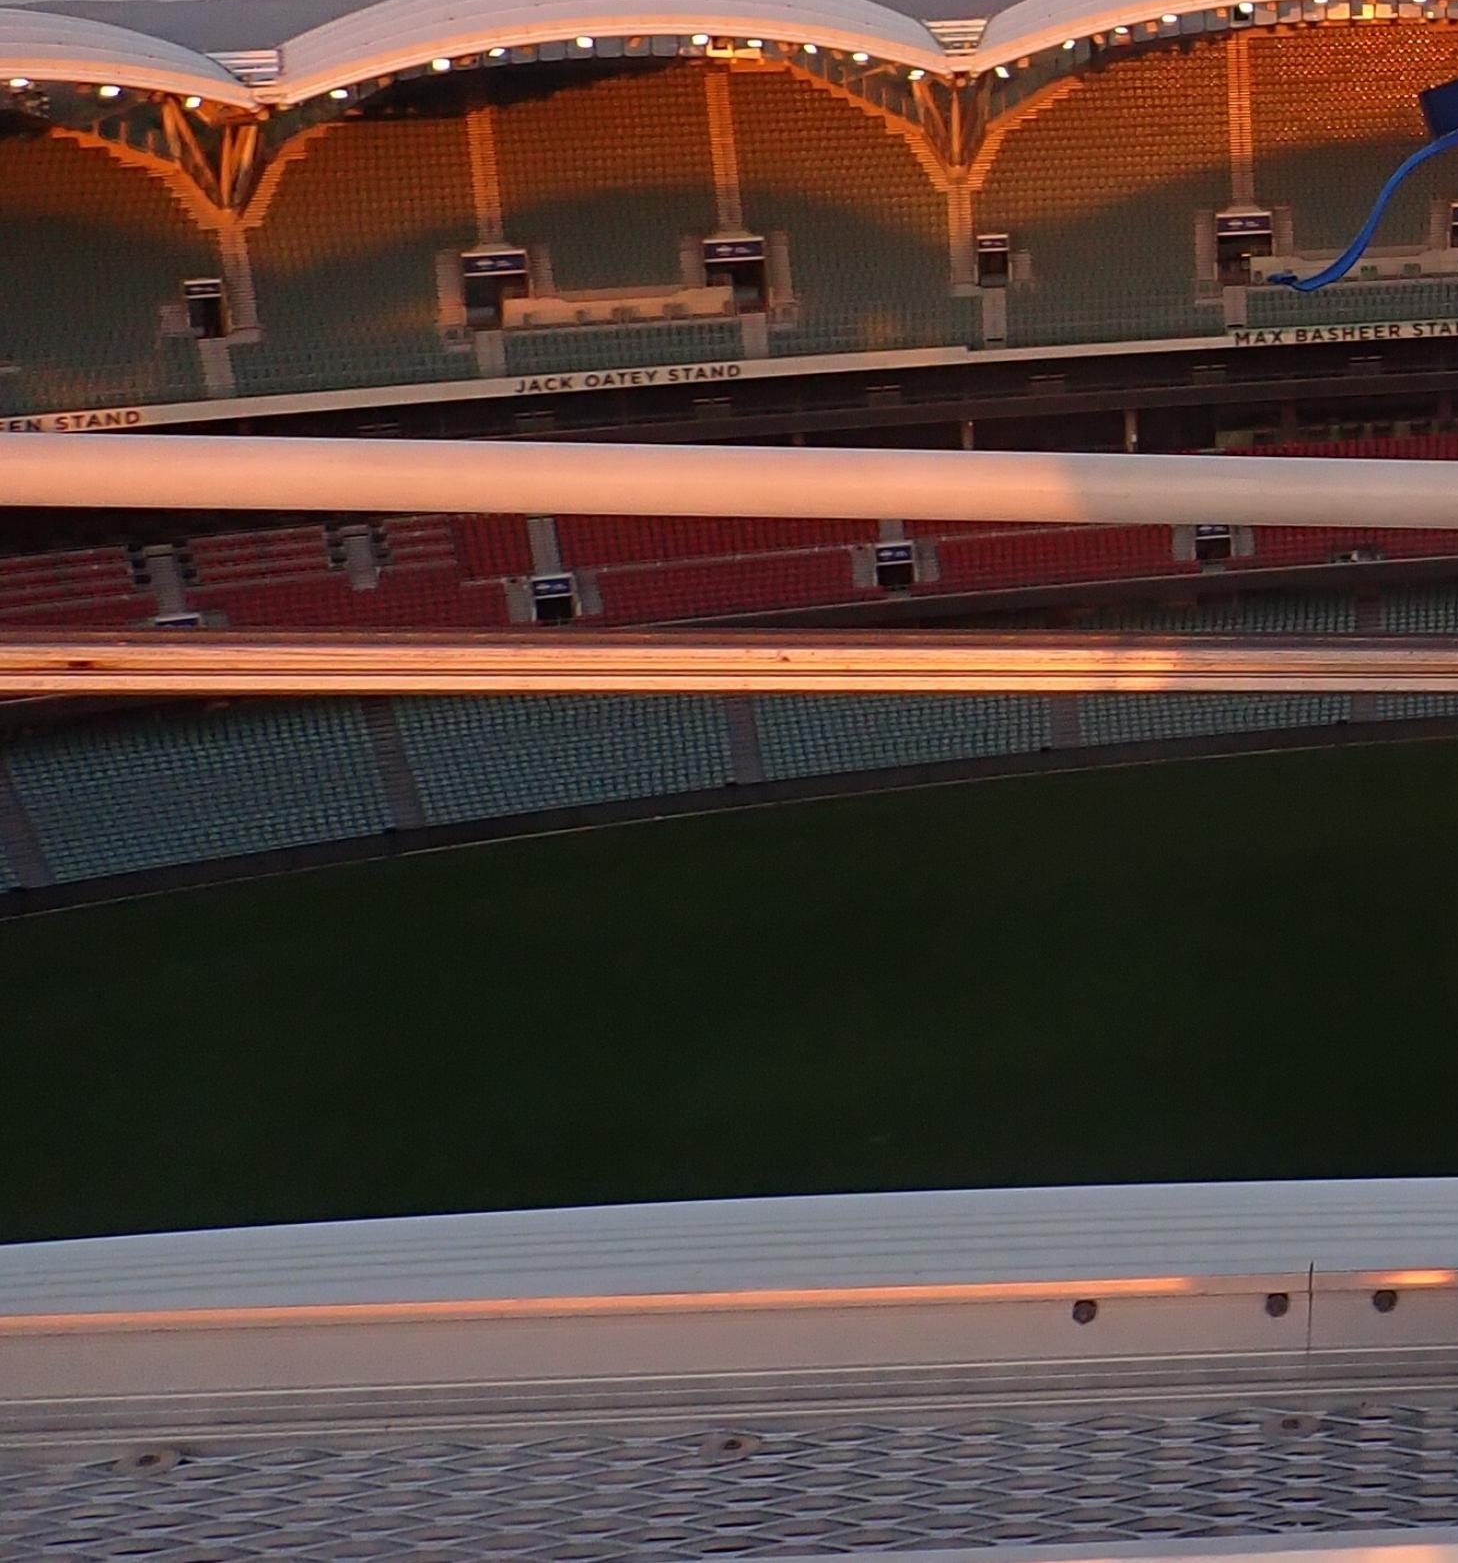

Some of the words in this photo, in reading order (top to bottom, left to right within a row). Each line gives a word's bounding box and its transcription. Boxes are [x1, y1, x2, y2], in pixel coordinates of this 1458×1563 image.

[1235, 331, 1283, 347] MAX
[1296, 324, 1401, 343] BASHEER
[515, 376, 573, 394] JACK
[585, 369, 659, 388] OATEY
[668, 364, 742, 382] STAND
[55, 410, 140, 431] STAND
